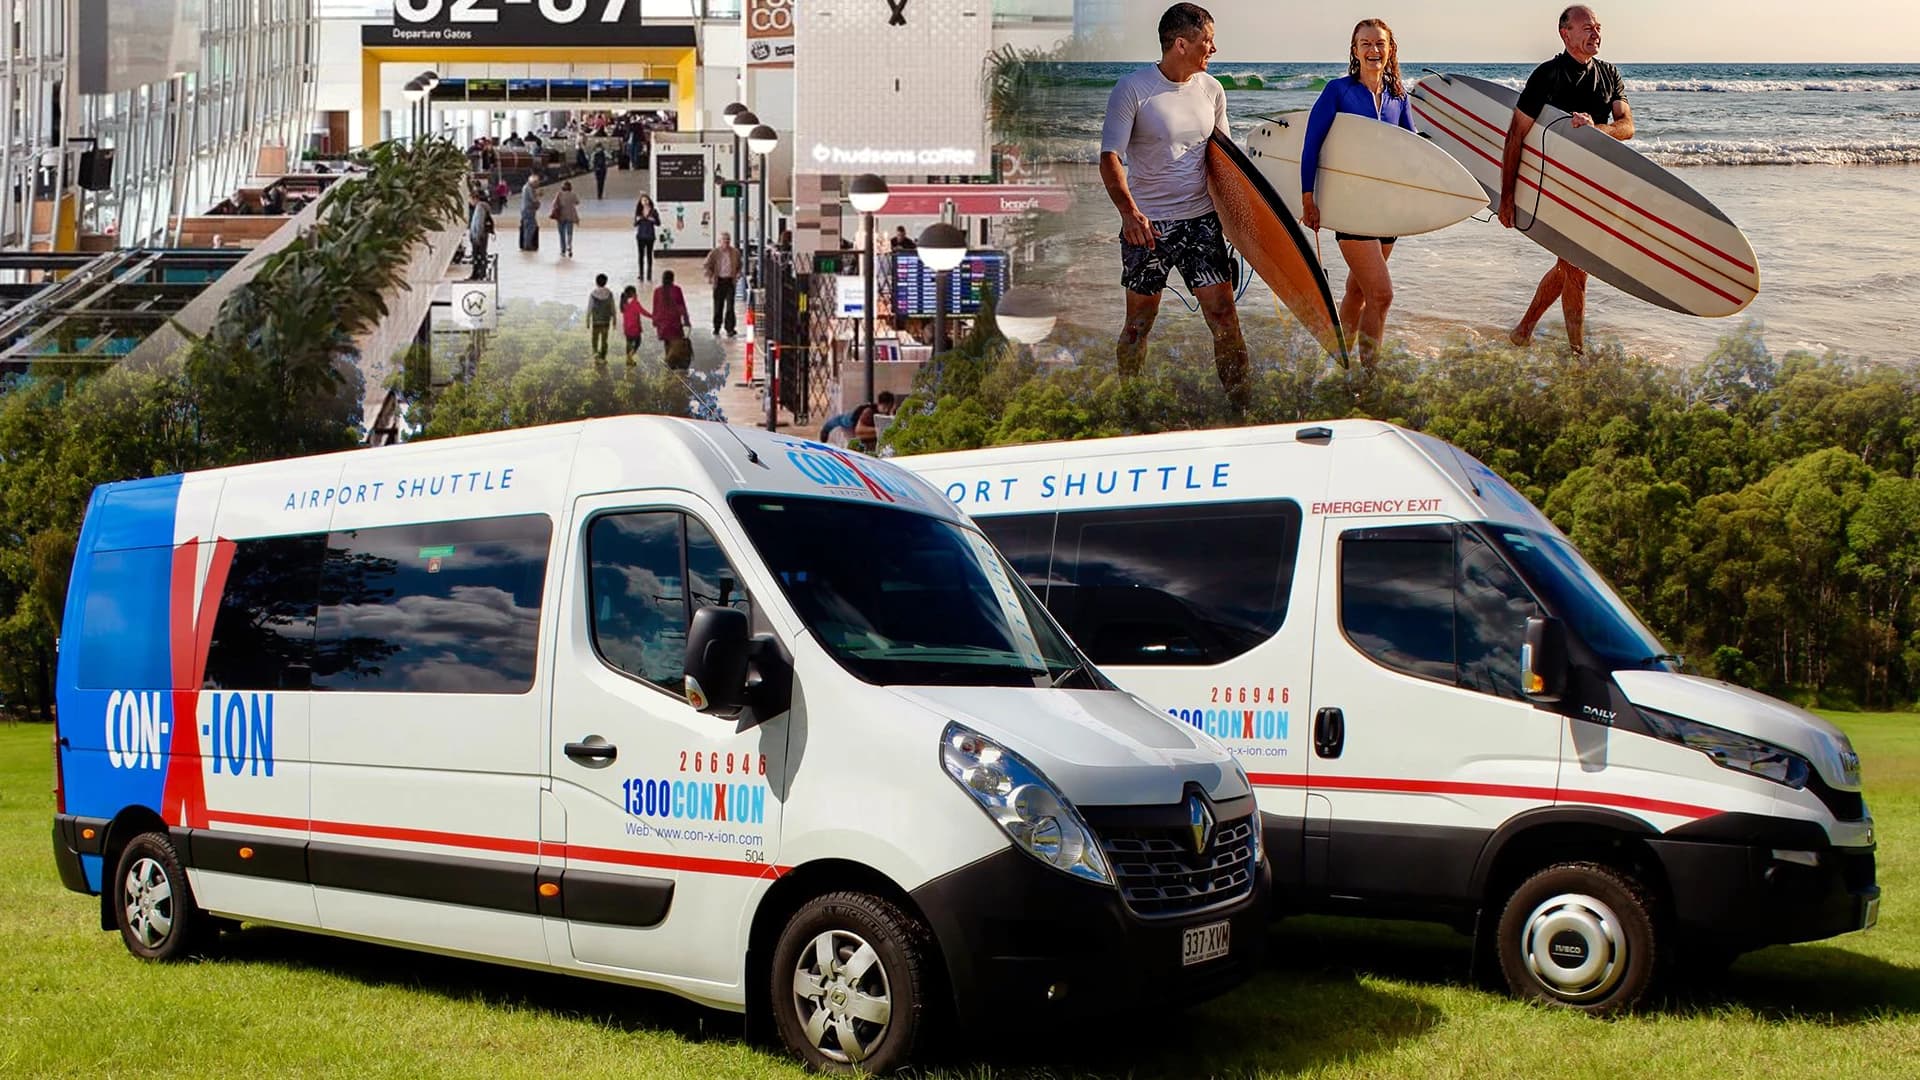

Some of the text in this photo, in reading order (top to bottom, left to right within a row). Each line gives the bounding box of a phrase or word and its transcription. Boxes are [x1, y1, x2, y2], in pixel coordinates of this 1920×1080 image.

[392, 28, 472, 40] Departure Gates
[1041, 463, 1230, 498] SHUTTLE
[285, 468, 514, 511] AIRPORT SHUTTLE
[1312, 499, 1442, 514] EMERGENCY EXIT
[1583, 705, 1617, 719] DAILY
[623, 778, 765, 824] 1300CONXION
[656, 828, 763, 846] www.con-x-ion.com
[745, 849, 765, 863] 504
[1555, 944, 1582, 954] IVECO
